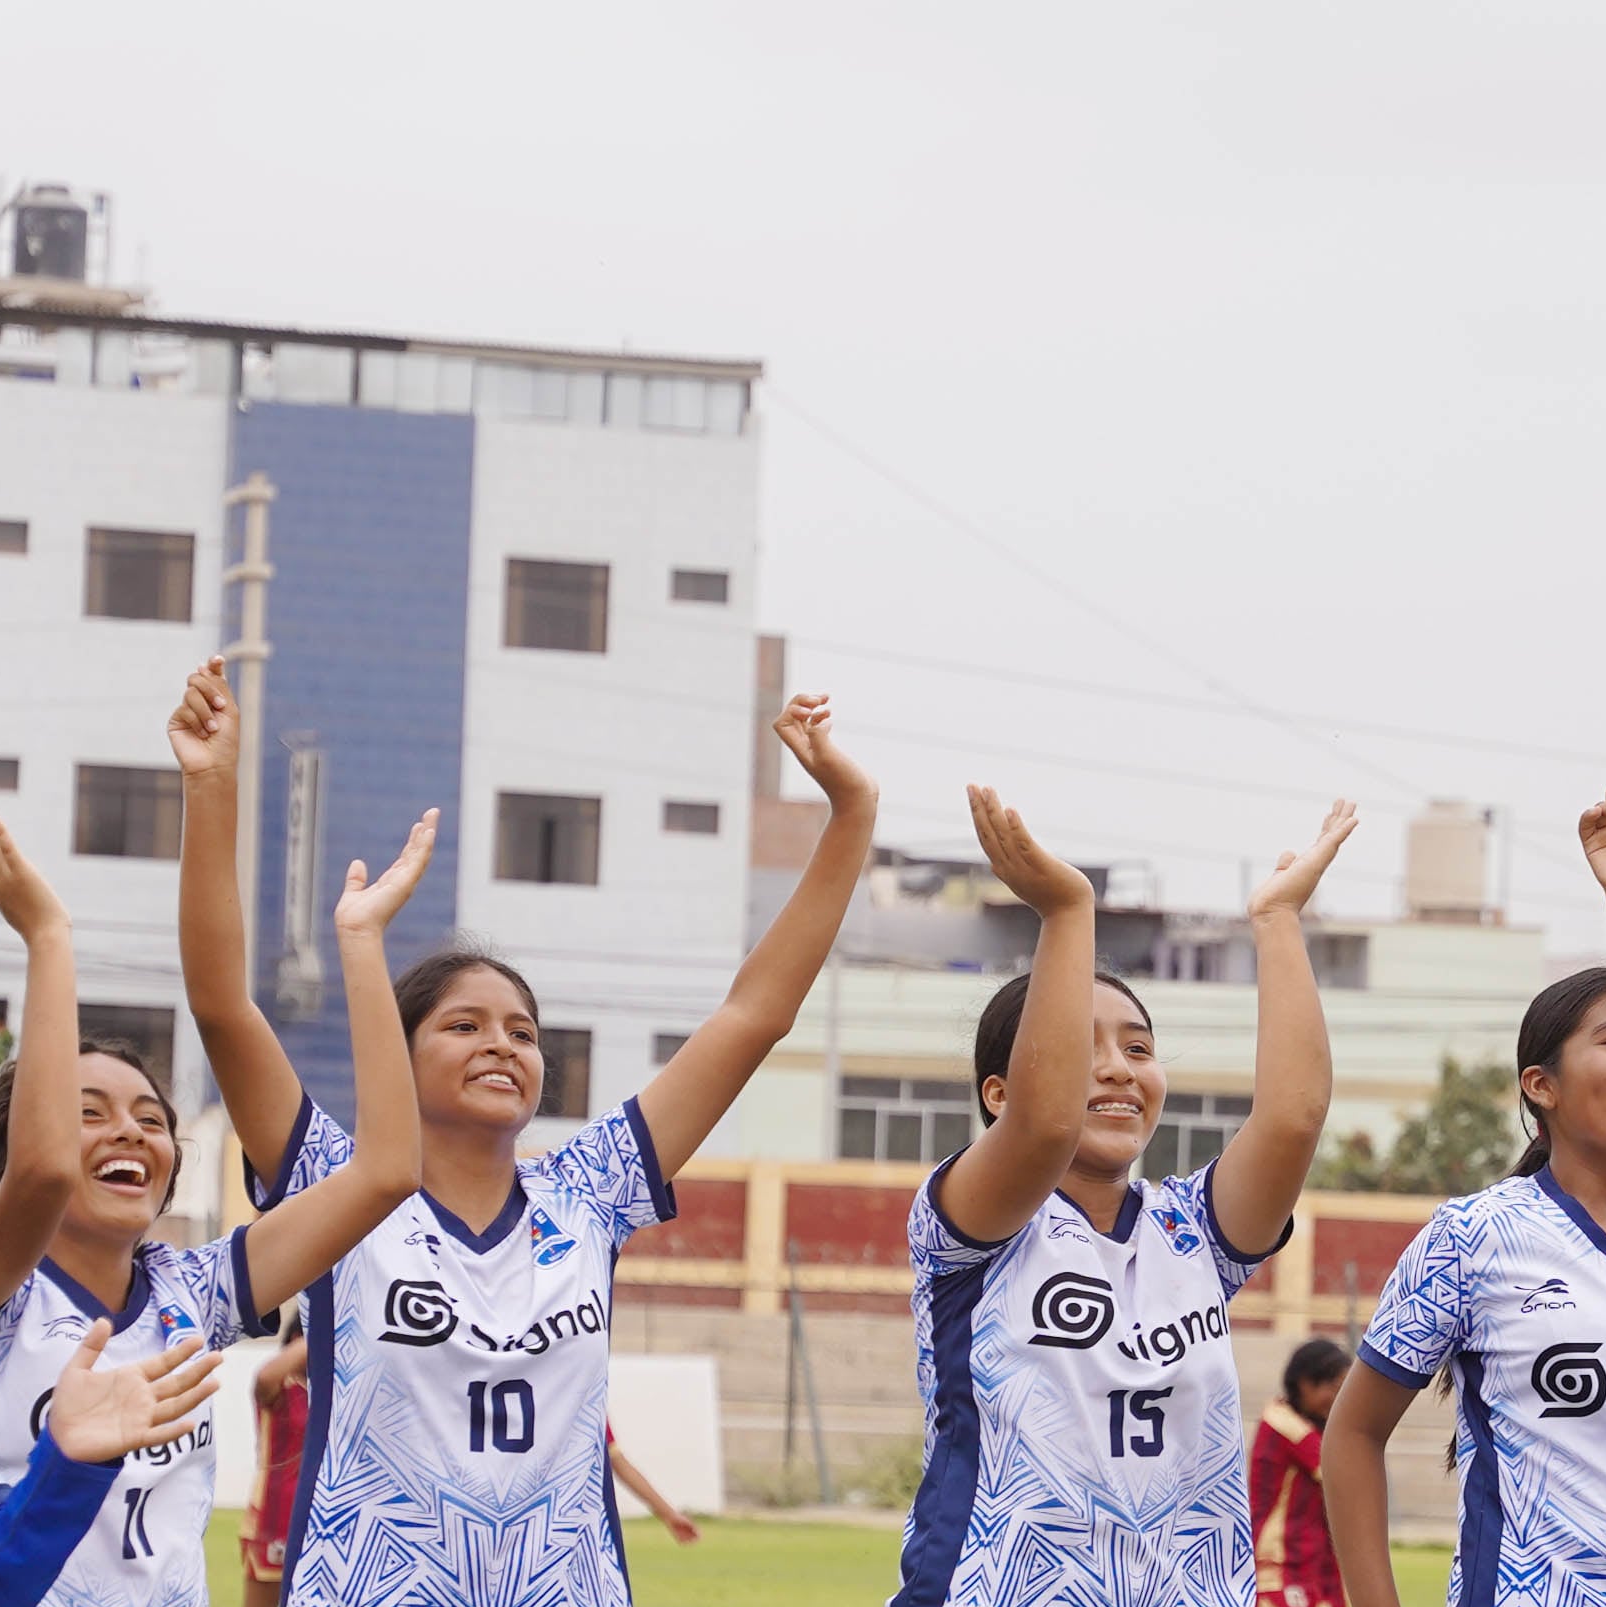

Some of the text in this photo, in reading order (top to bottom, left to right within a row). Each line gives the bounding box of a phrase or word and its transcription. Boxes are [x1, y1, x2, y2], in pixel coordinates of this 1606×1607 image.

[1047, 1231, 1090, 1243] orio
[1520, 1301, 1577, 1314] orion
[467, 1379, 535, 1453] 10
[1107, 1386, 1174, 1458] 15
